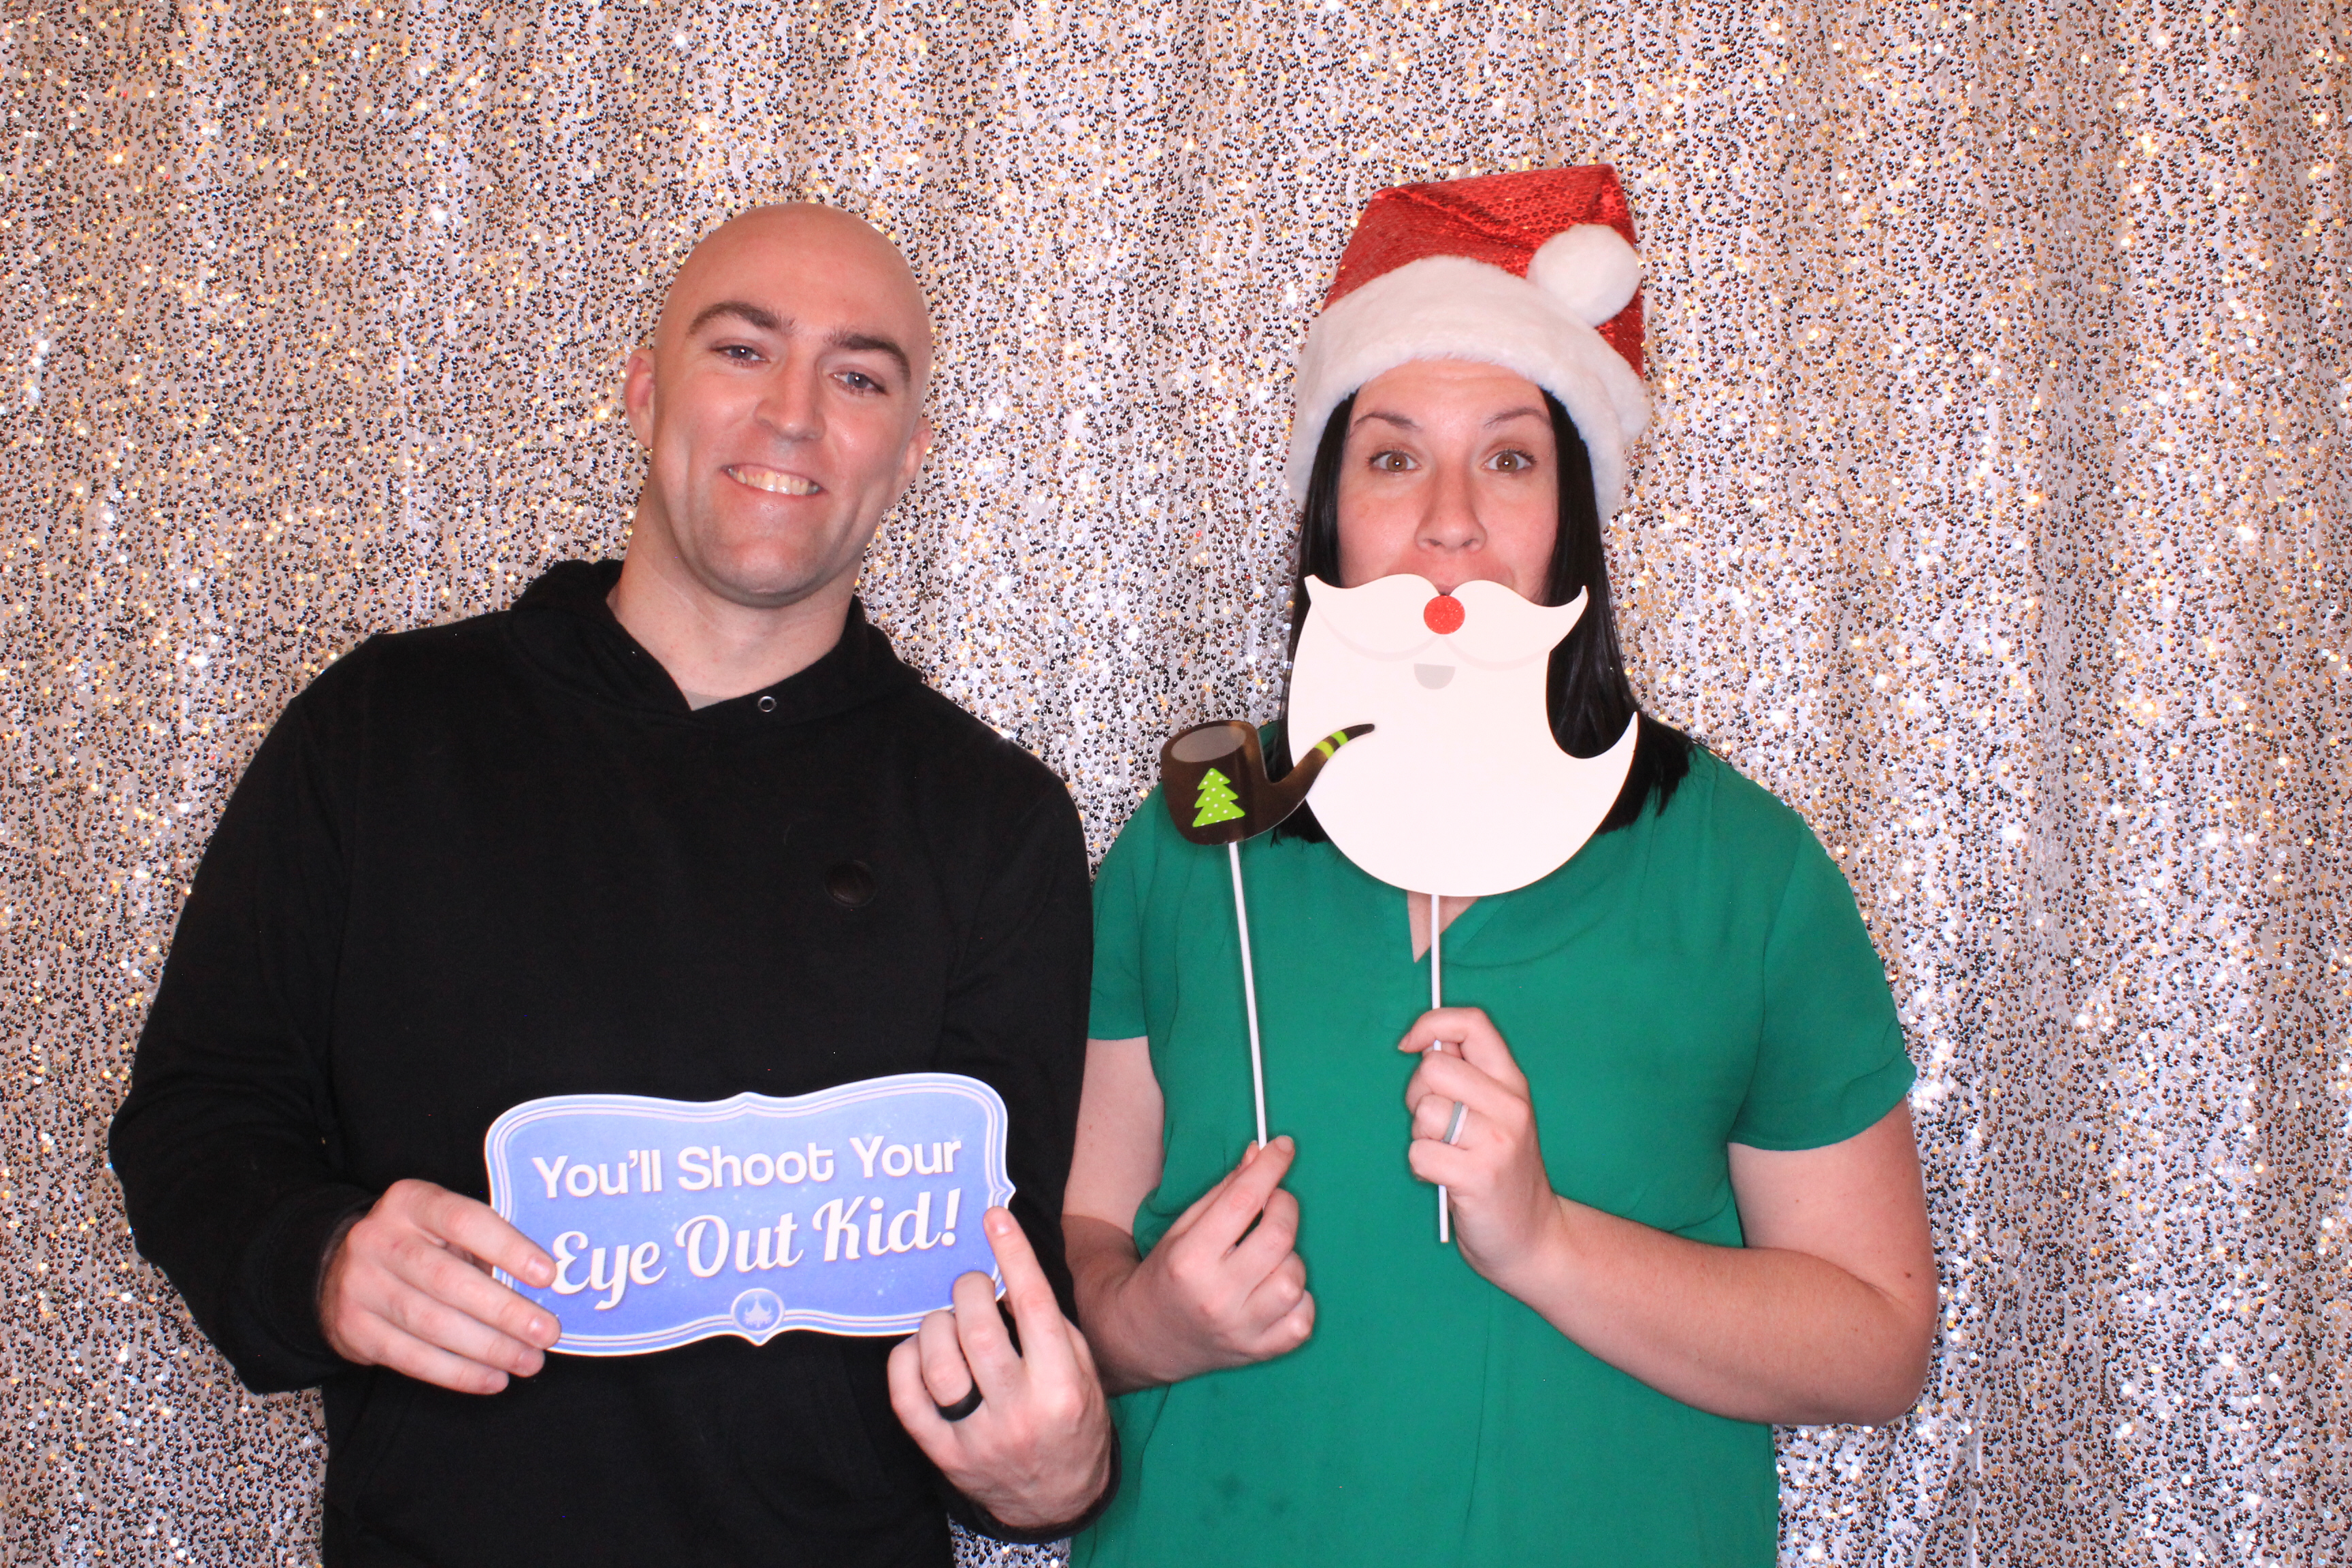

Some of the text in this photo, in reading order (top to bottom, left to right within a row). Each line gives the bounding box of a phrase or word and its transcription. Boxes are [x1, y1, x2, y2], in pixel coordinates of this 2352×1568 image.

[532, 1134, 962, 1199] You'll Shoot Your
[549, 1188, 961, 1310] Eye Out Kid!
